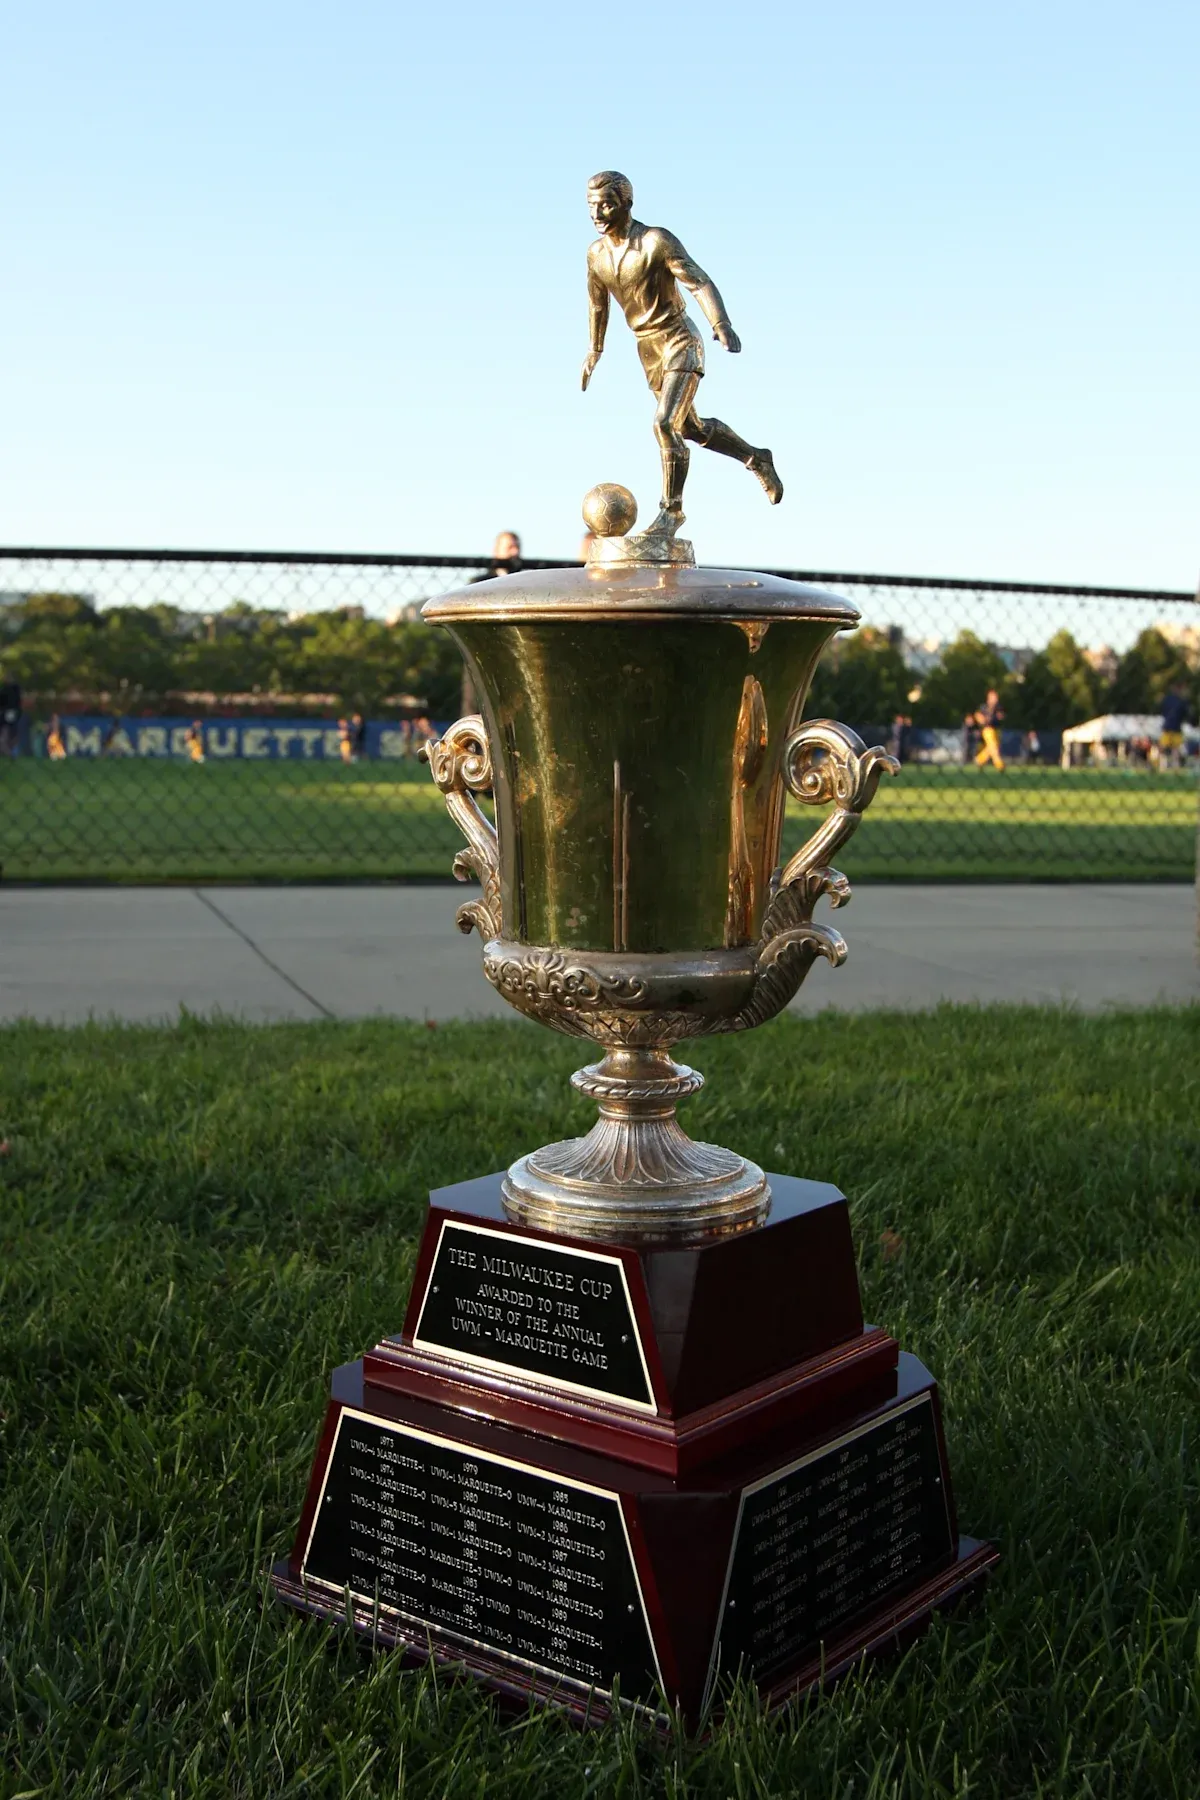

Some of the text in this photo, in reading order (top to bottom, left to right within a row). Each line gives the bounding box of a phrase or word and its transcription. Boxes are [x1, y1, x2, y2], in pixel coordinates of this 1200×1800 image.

[448, 1247, 612, 1300] THE MILWAUKEE CUP
[455, 1297, 605, 1347] WINNER OF THE ANNUAL
[476, 1283, 580, 1320] AWARDED TO THE
[451, 1316, 481, 1336] UWM
[495, 1327, 568, 1359] MARQUETTE
[571, 1348, 609, 1370] GAME
